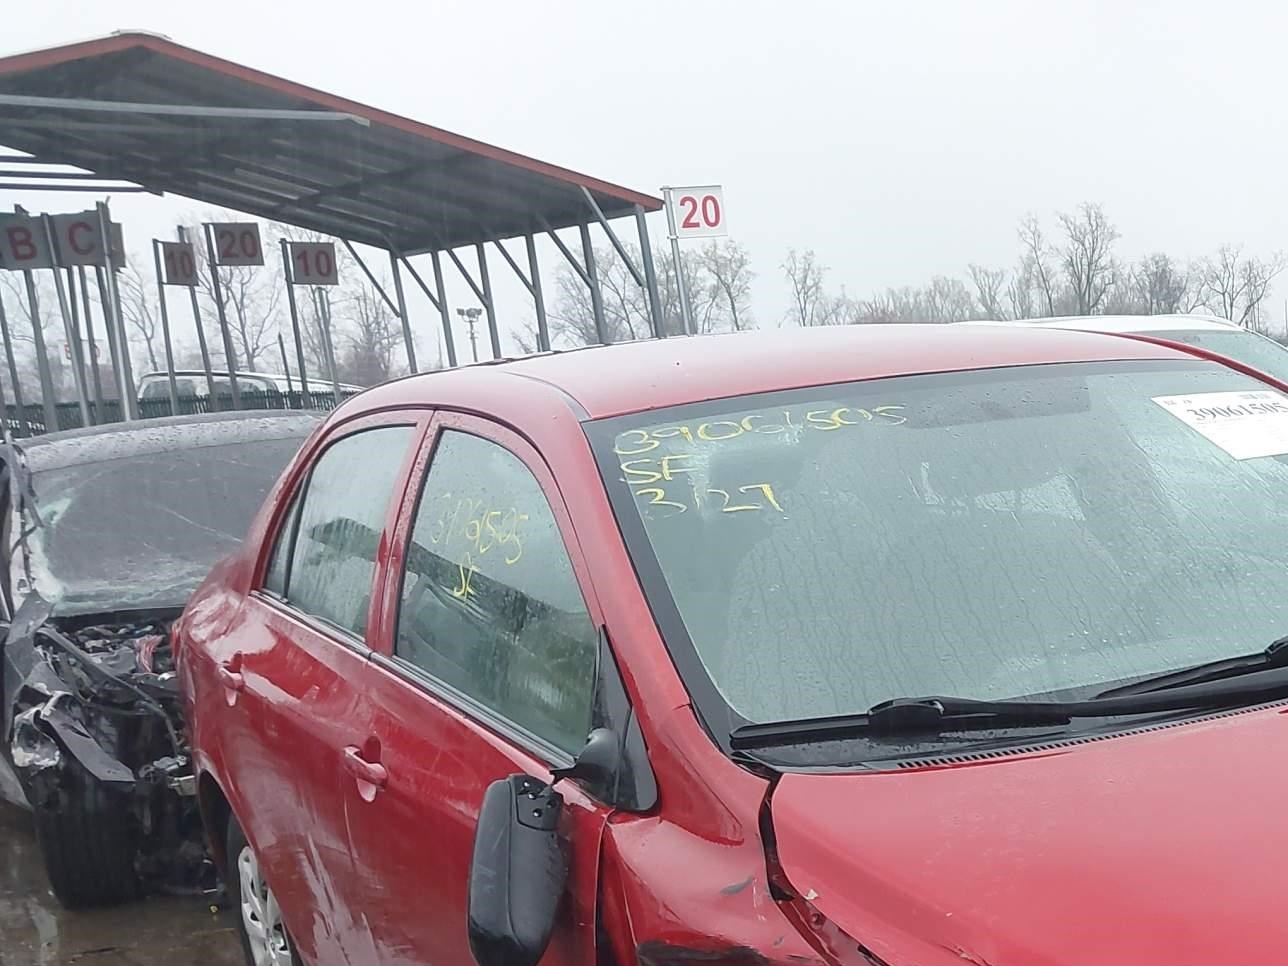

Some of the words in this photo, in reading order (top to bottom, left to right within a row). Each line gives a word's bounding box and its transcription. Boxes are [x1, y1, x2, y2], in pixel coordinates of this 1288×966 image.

[679, 194, 721, 229] 20
[7, 226, 38, 261] B
[66, 221, 96, 256] C
[218, 230, 258, 259] 20
[166, 249, 195, 279] 10
[296, 248, 333, 277] 10
